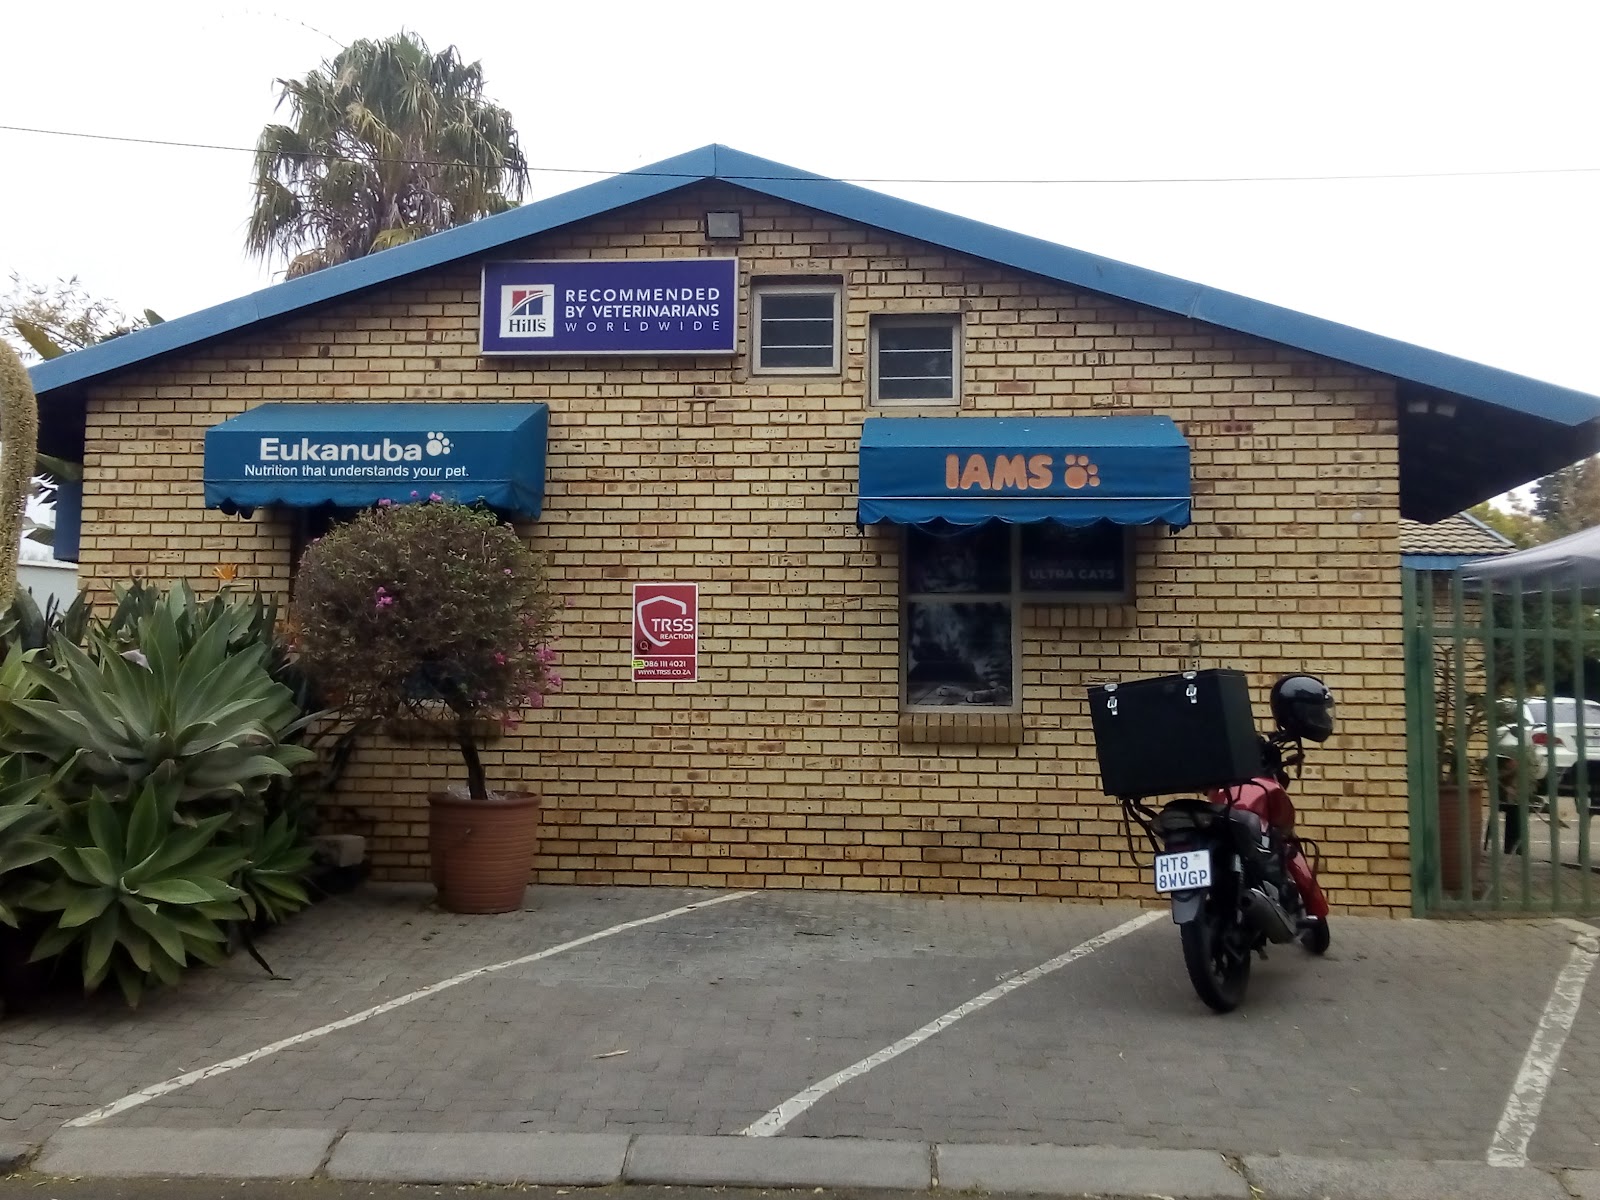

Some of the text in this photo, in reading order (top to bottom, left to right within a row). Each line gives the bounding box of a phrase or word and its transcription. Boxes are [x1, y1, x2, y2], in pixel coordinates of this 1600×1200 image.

[565, 288, 720, 302] RECOMMENDED
[565, 304, 720, 318] BY VETERINARIANS
[508, 318, 546, 333] Hill's
[565, 320, 720, 332] WORLDWIDE
[260, 437, 422, 462] Eukanuba
[244, 464, 469, 480] Nutrition that understands your pet.
[945, 453, 1053, 491] IAMS
[1029, 568, 1116, 580] ULTRA CATS
[651, 618, 694, 632] TRSS
[644, 660, 659, 668] 086
[669, 660, 686, 668] 4021
[1160, 856, 1189, 873] HT8
[1159, 869, 1208, 889] 8WVGP
